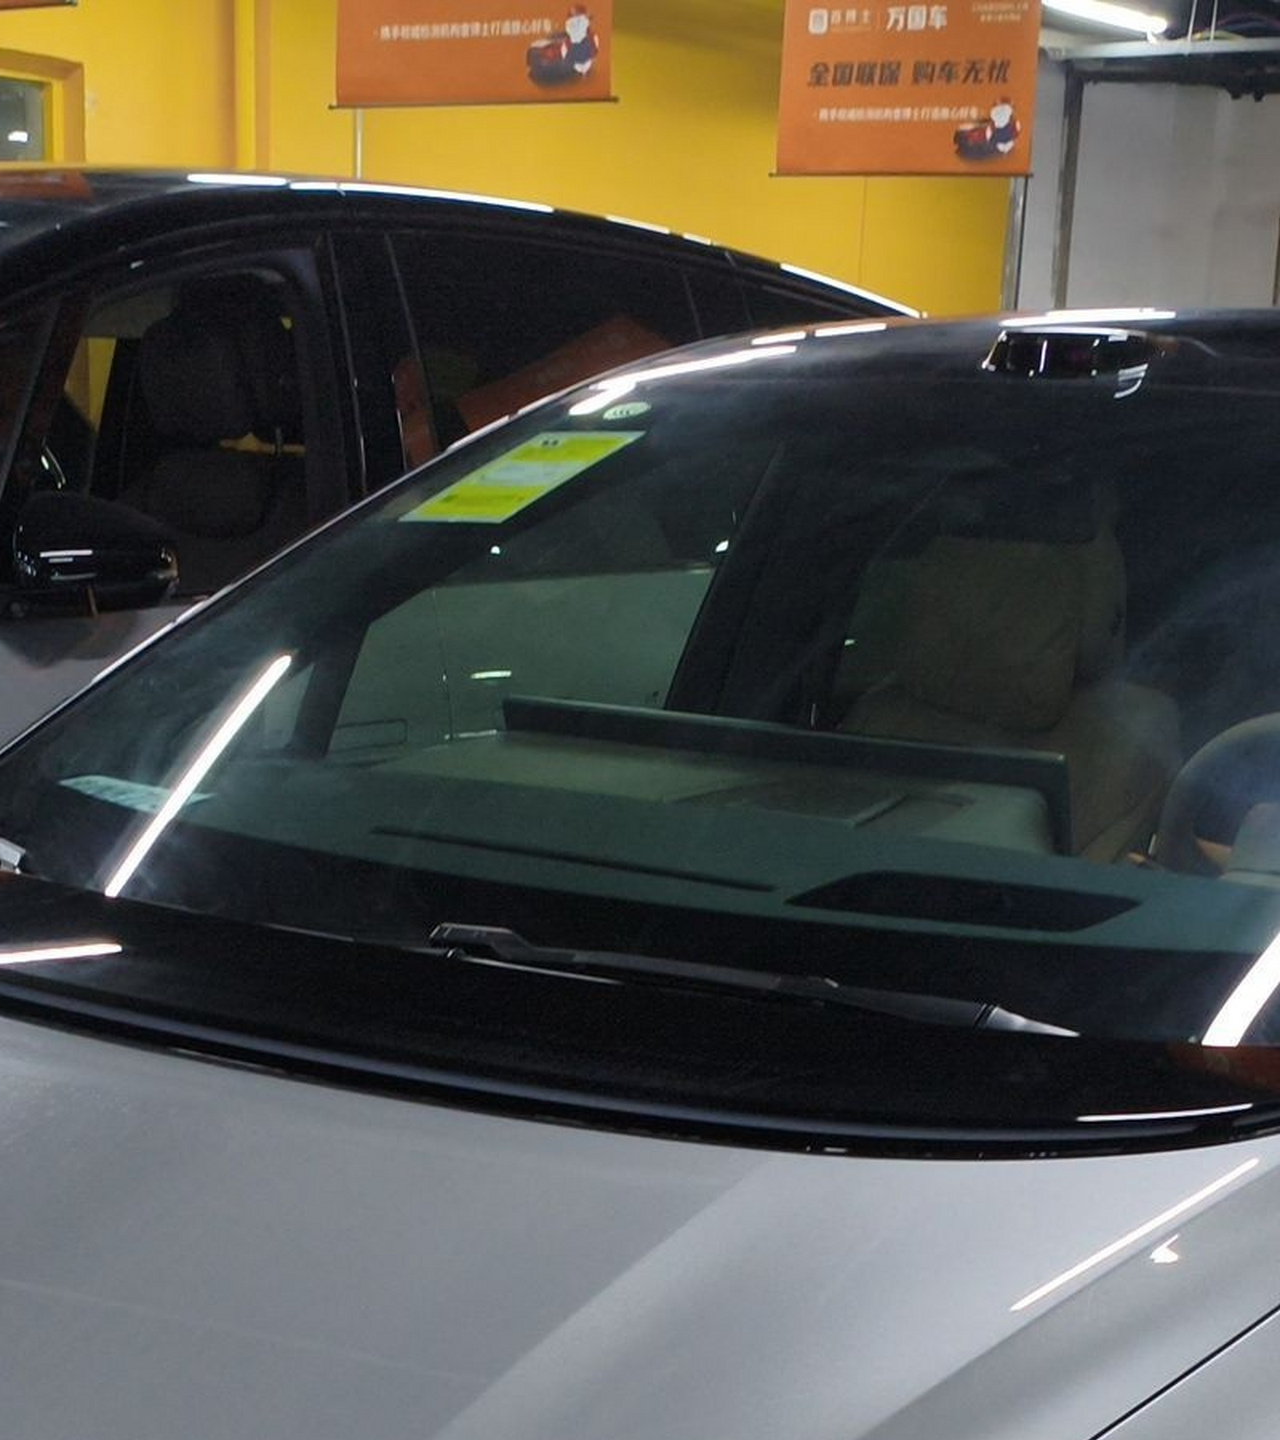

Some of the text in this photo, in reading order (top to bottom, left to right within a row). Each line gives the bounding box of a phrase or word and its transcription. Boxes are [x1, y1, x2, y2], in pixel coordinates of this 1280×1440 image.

[886, 5, 948, 31] 万国车
[808, 58, 1011, 87] 全国联保 购车无忧
